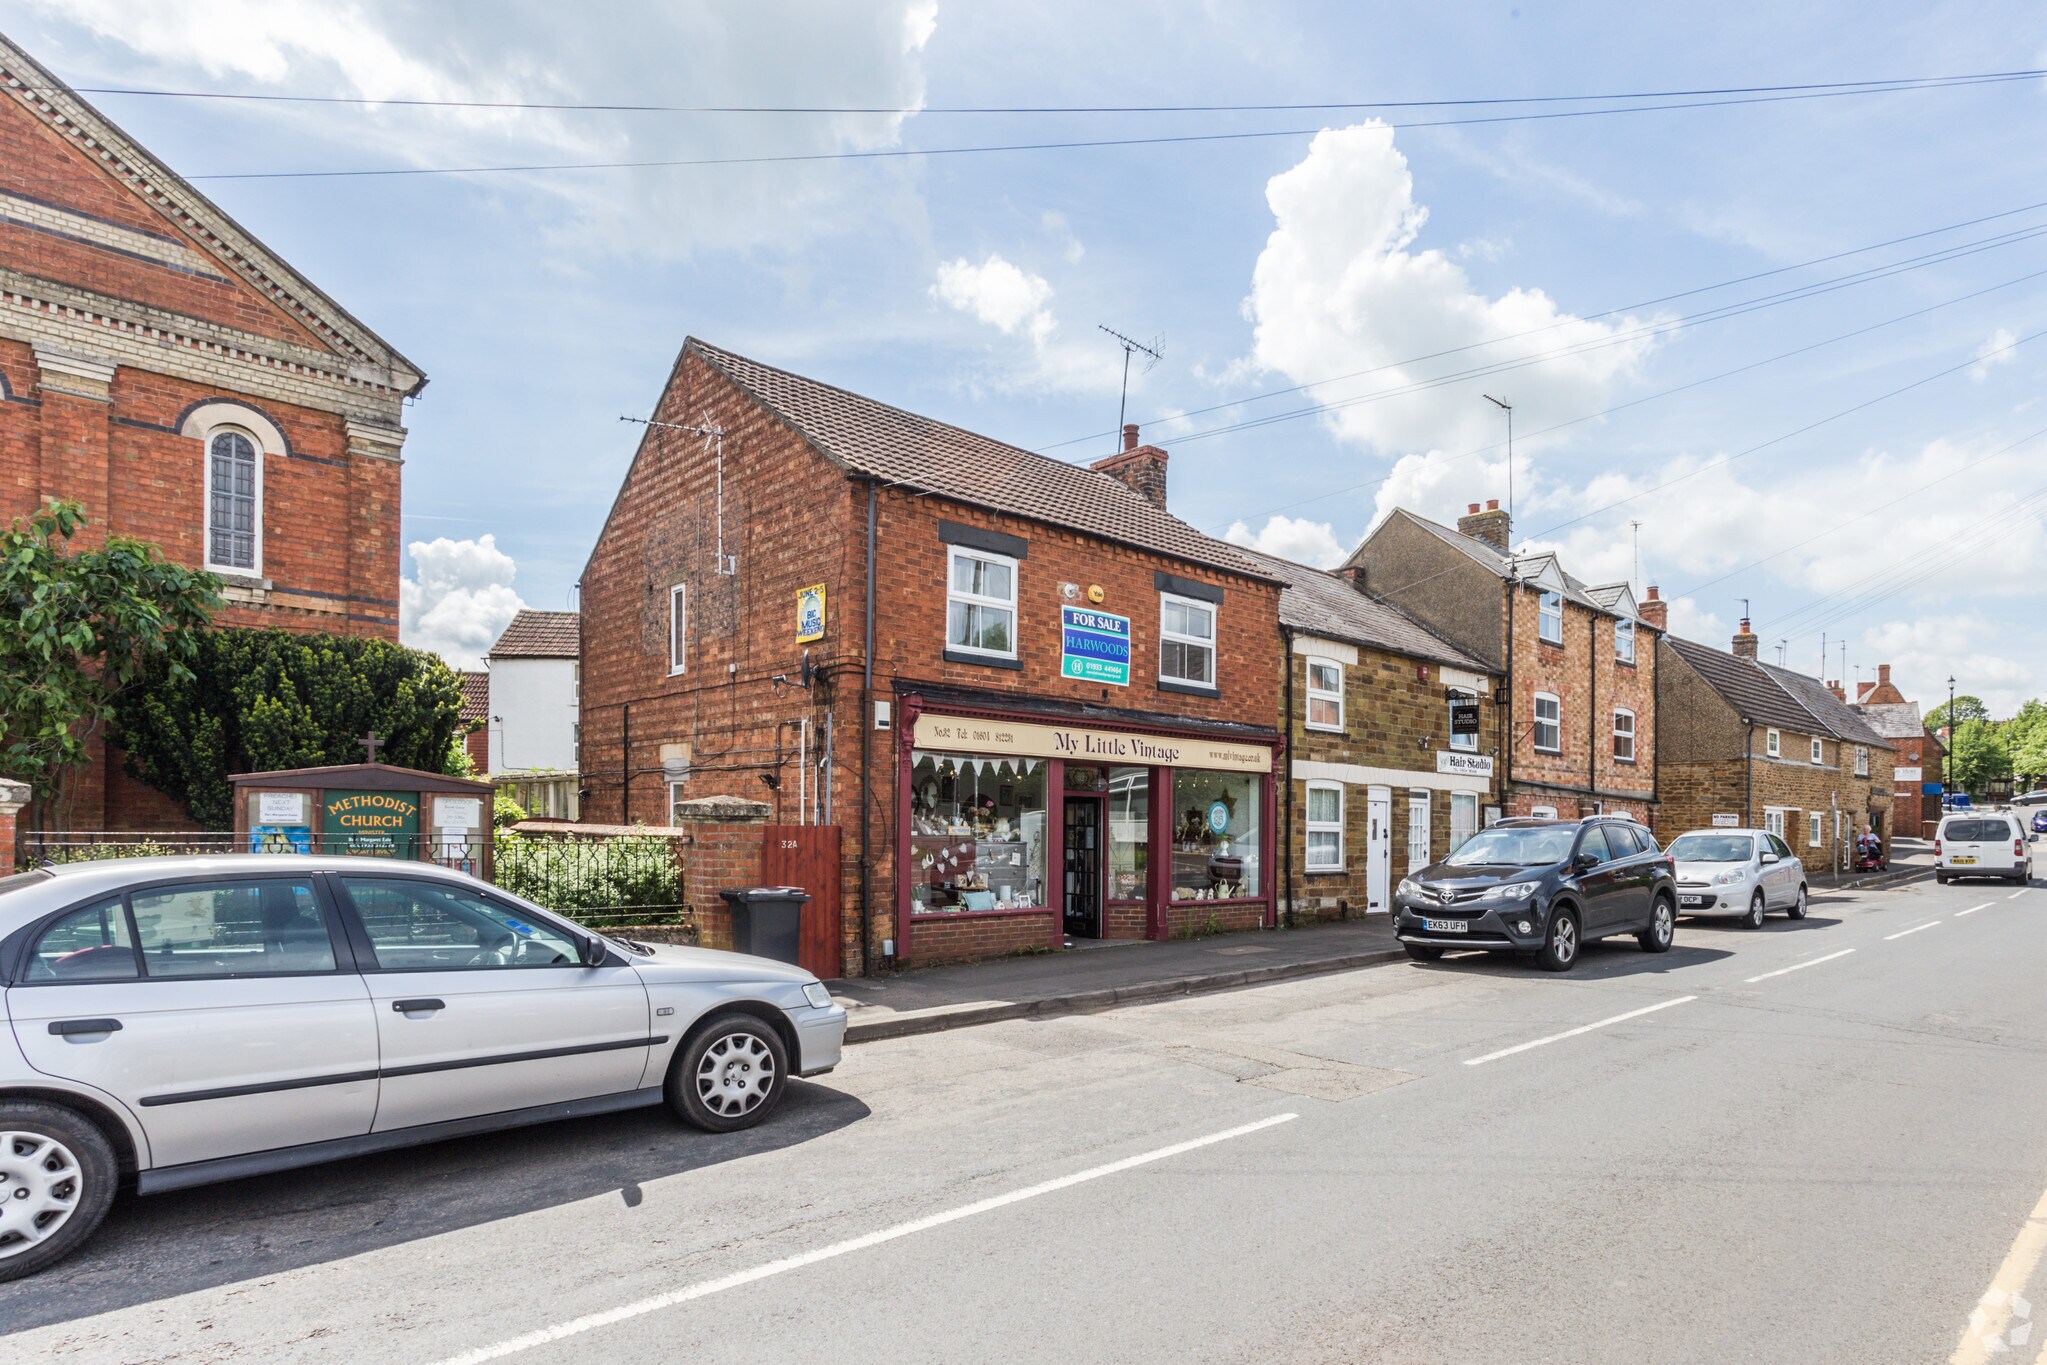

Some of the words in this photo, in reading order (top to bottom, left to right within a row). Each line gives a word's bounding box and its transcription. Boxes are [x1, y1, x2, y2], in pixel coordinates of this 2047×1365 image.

[798, 588, 813, 599] JUNE
[801, 617, 821, 629] MUSIC
[1073, 612, 1095, 627] FOR
[1097, 617, 1121, 632] SALE
[1066, 635, 1128, 657] HARWOODS
[1054, 732, 1079, 755] My
[1085, 734, 1126, 755] Little
[1131, 739, 1179, 762] Vintage
[1450, 756, 1466, 767] Hair
[1468, 758, 1490, 770] Studio
[328, 795, 416, 815] METHODIST
[340, 815, 403, 827] CHURCH
[781, 840, 798, 849] 32A
[1428, 920, 1448, 930] EK63
[1450, 921, 1466, 930] UFH
